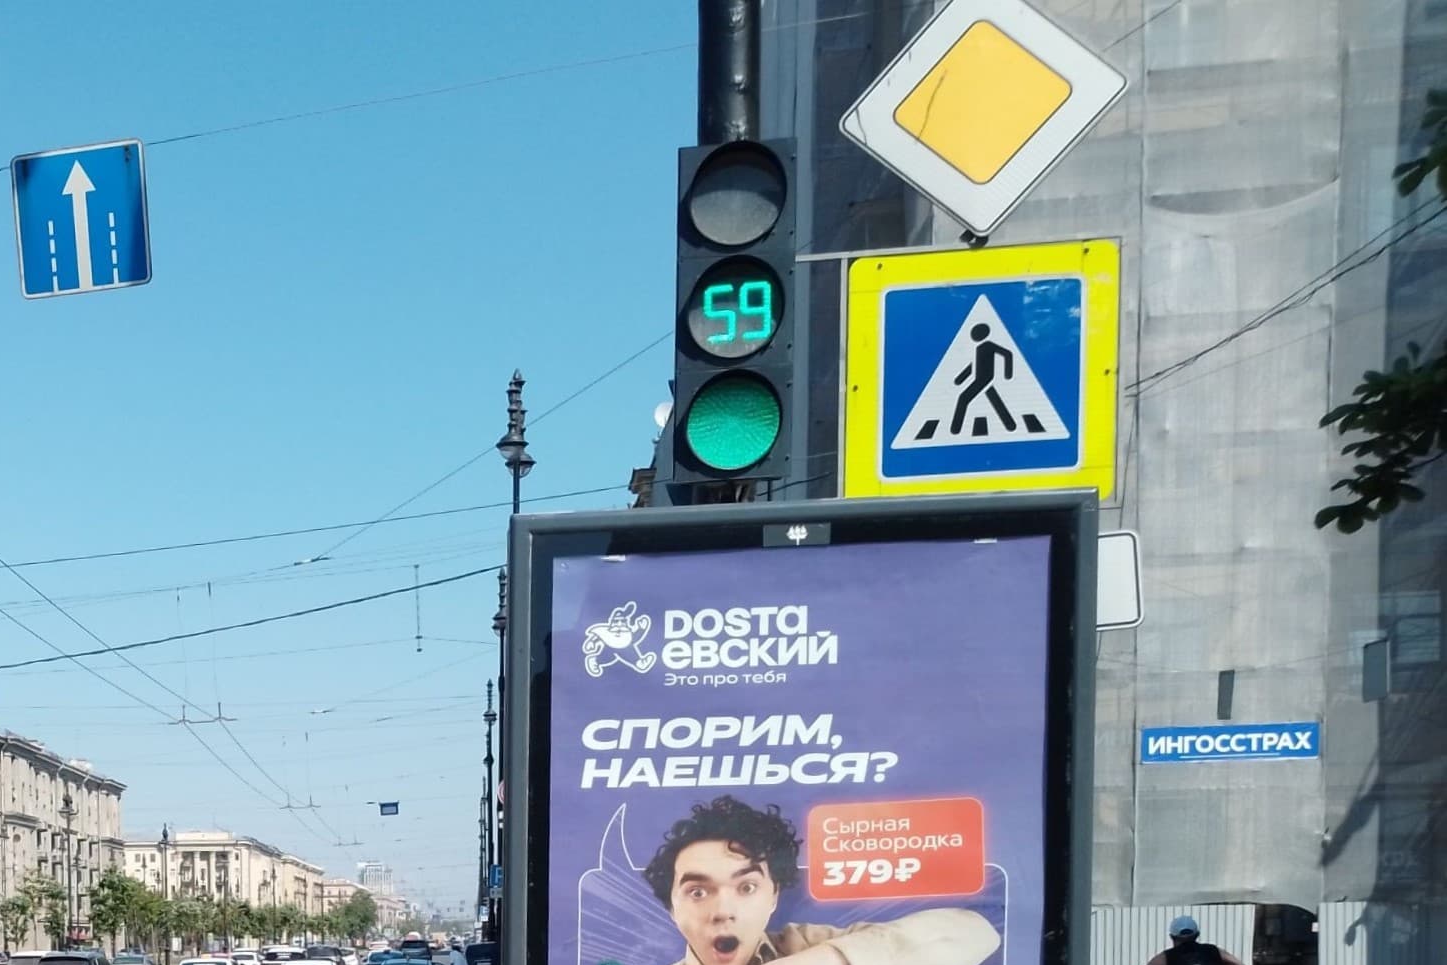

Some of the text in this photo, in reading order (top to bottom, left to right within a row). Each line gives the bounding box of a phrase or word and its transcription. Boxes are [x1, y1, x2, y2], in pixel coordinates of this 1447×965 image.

[704, 281, 771, 342] 59
[664, 670, 787, 687] Это про тебя
[581, 714, 843, 751] СПОРИМ,
[1148, 731, 1312, 755] ИНГОССТРАХ
[581, 751, 898, 789] НАЕШЬСЯ?
[823, 816, 910, 836] Сырная
[823, 833, 963, 853] Сковородка
